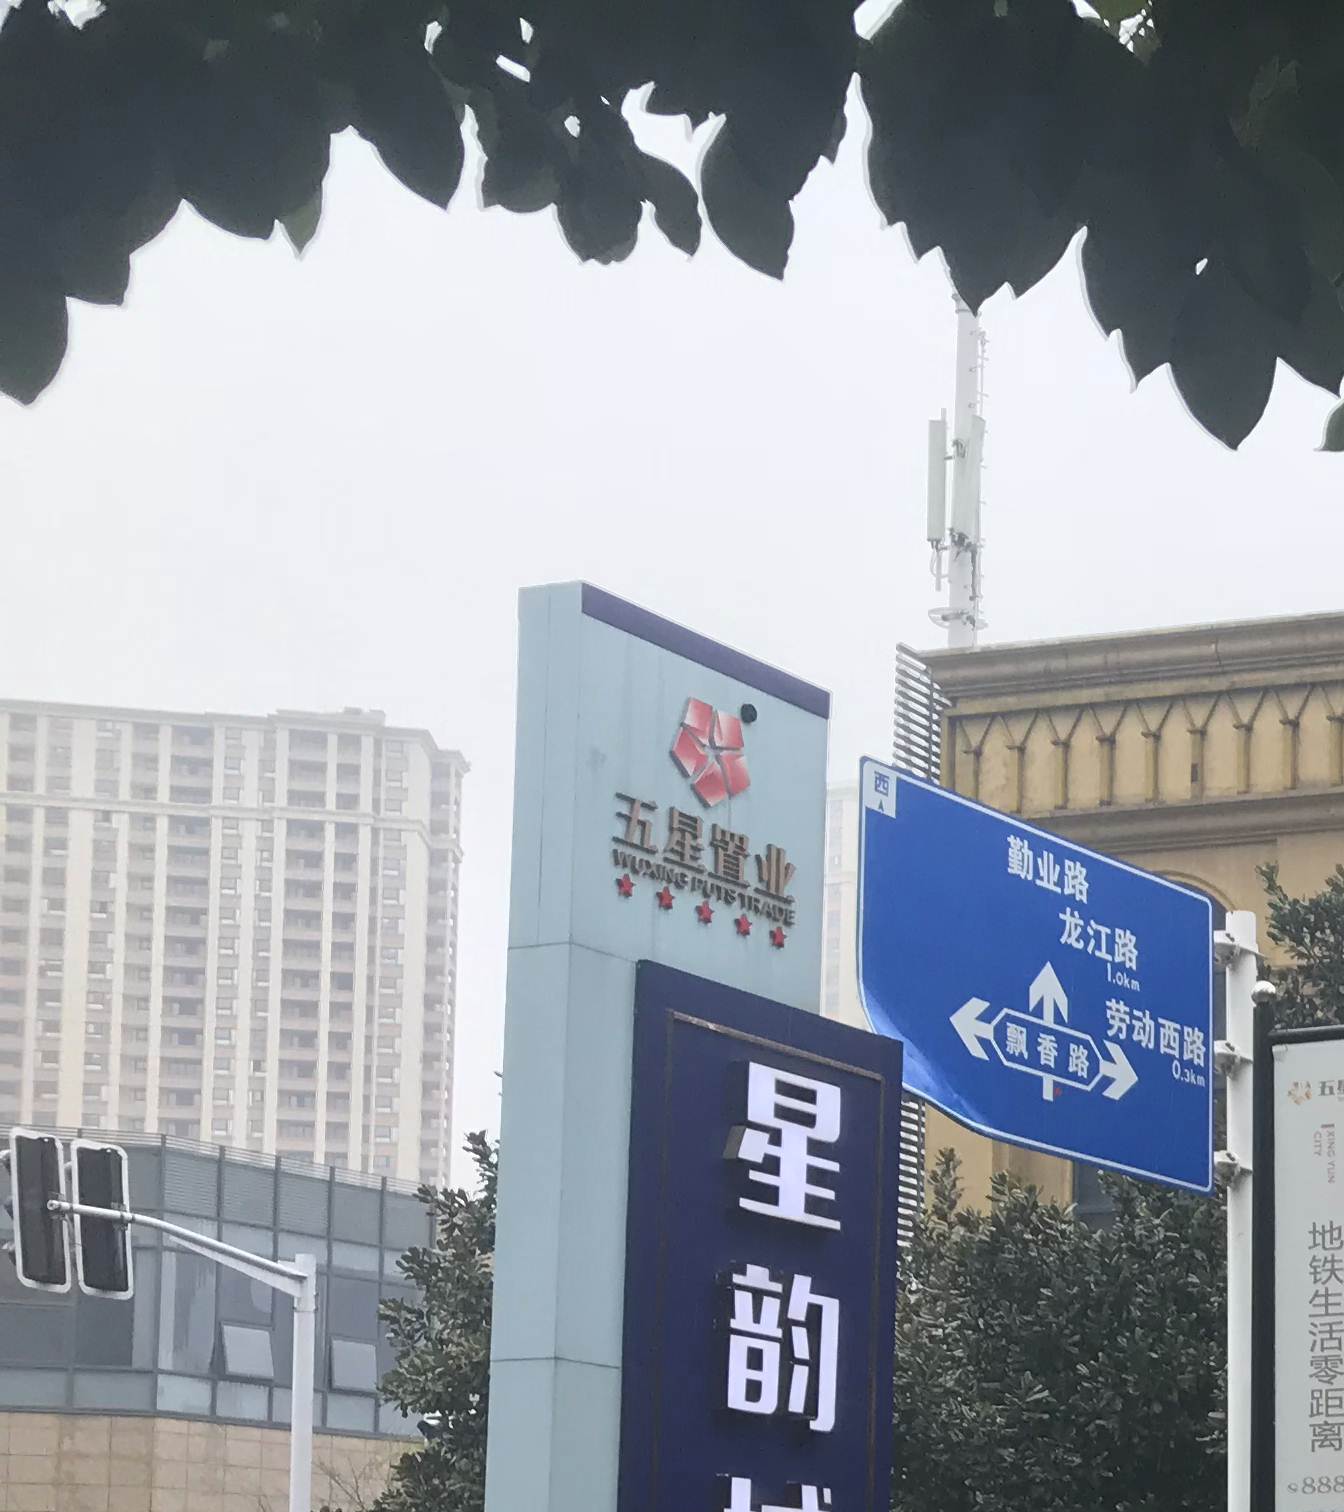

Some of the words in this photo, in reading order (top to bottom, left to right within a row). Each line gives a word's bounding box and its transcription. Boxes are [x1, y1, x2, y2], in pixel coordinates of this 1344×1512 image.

[874, 771, 890, 797] 西
[612, 792, 796, 905] 五星置业
[612, 849, 690, 890] WUXING
[1007, 834, 1089, 904] 勤业路
[1059, 907, 1138, 970] 龙江路
[1106, 962, 1140, 992] 1.0km
[1006, 1022, 1089, 1079] 飘香路
[1105, 999, 1206, 1067] 劳动西路
[1172, 1060, 1206, 1088] 0.3km
[1308, 1220, 1344, 1454] 地铁生活零距离
